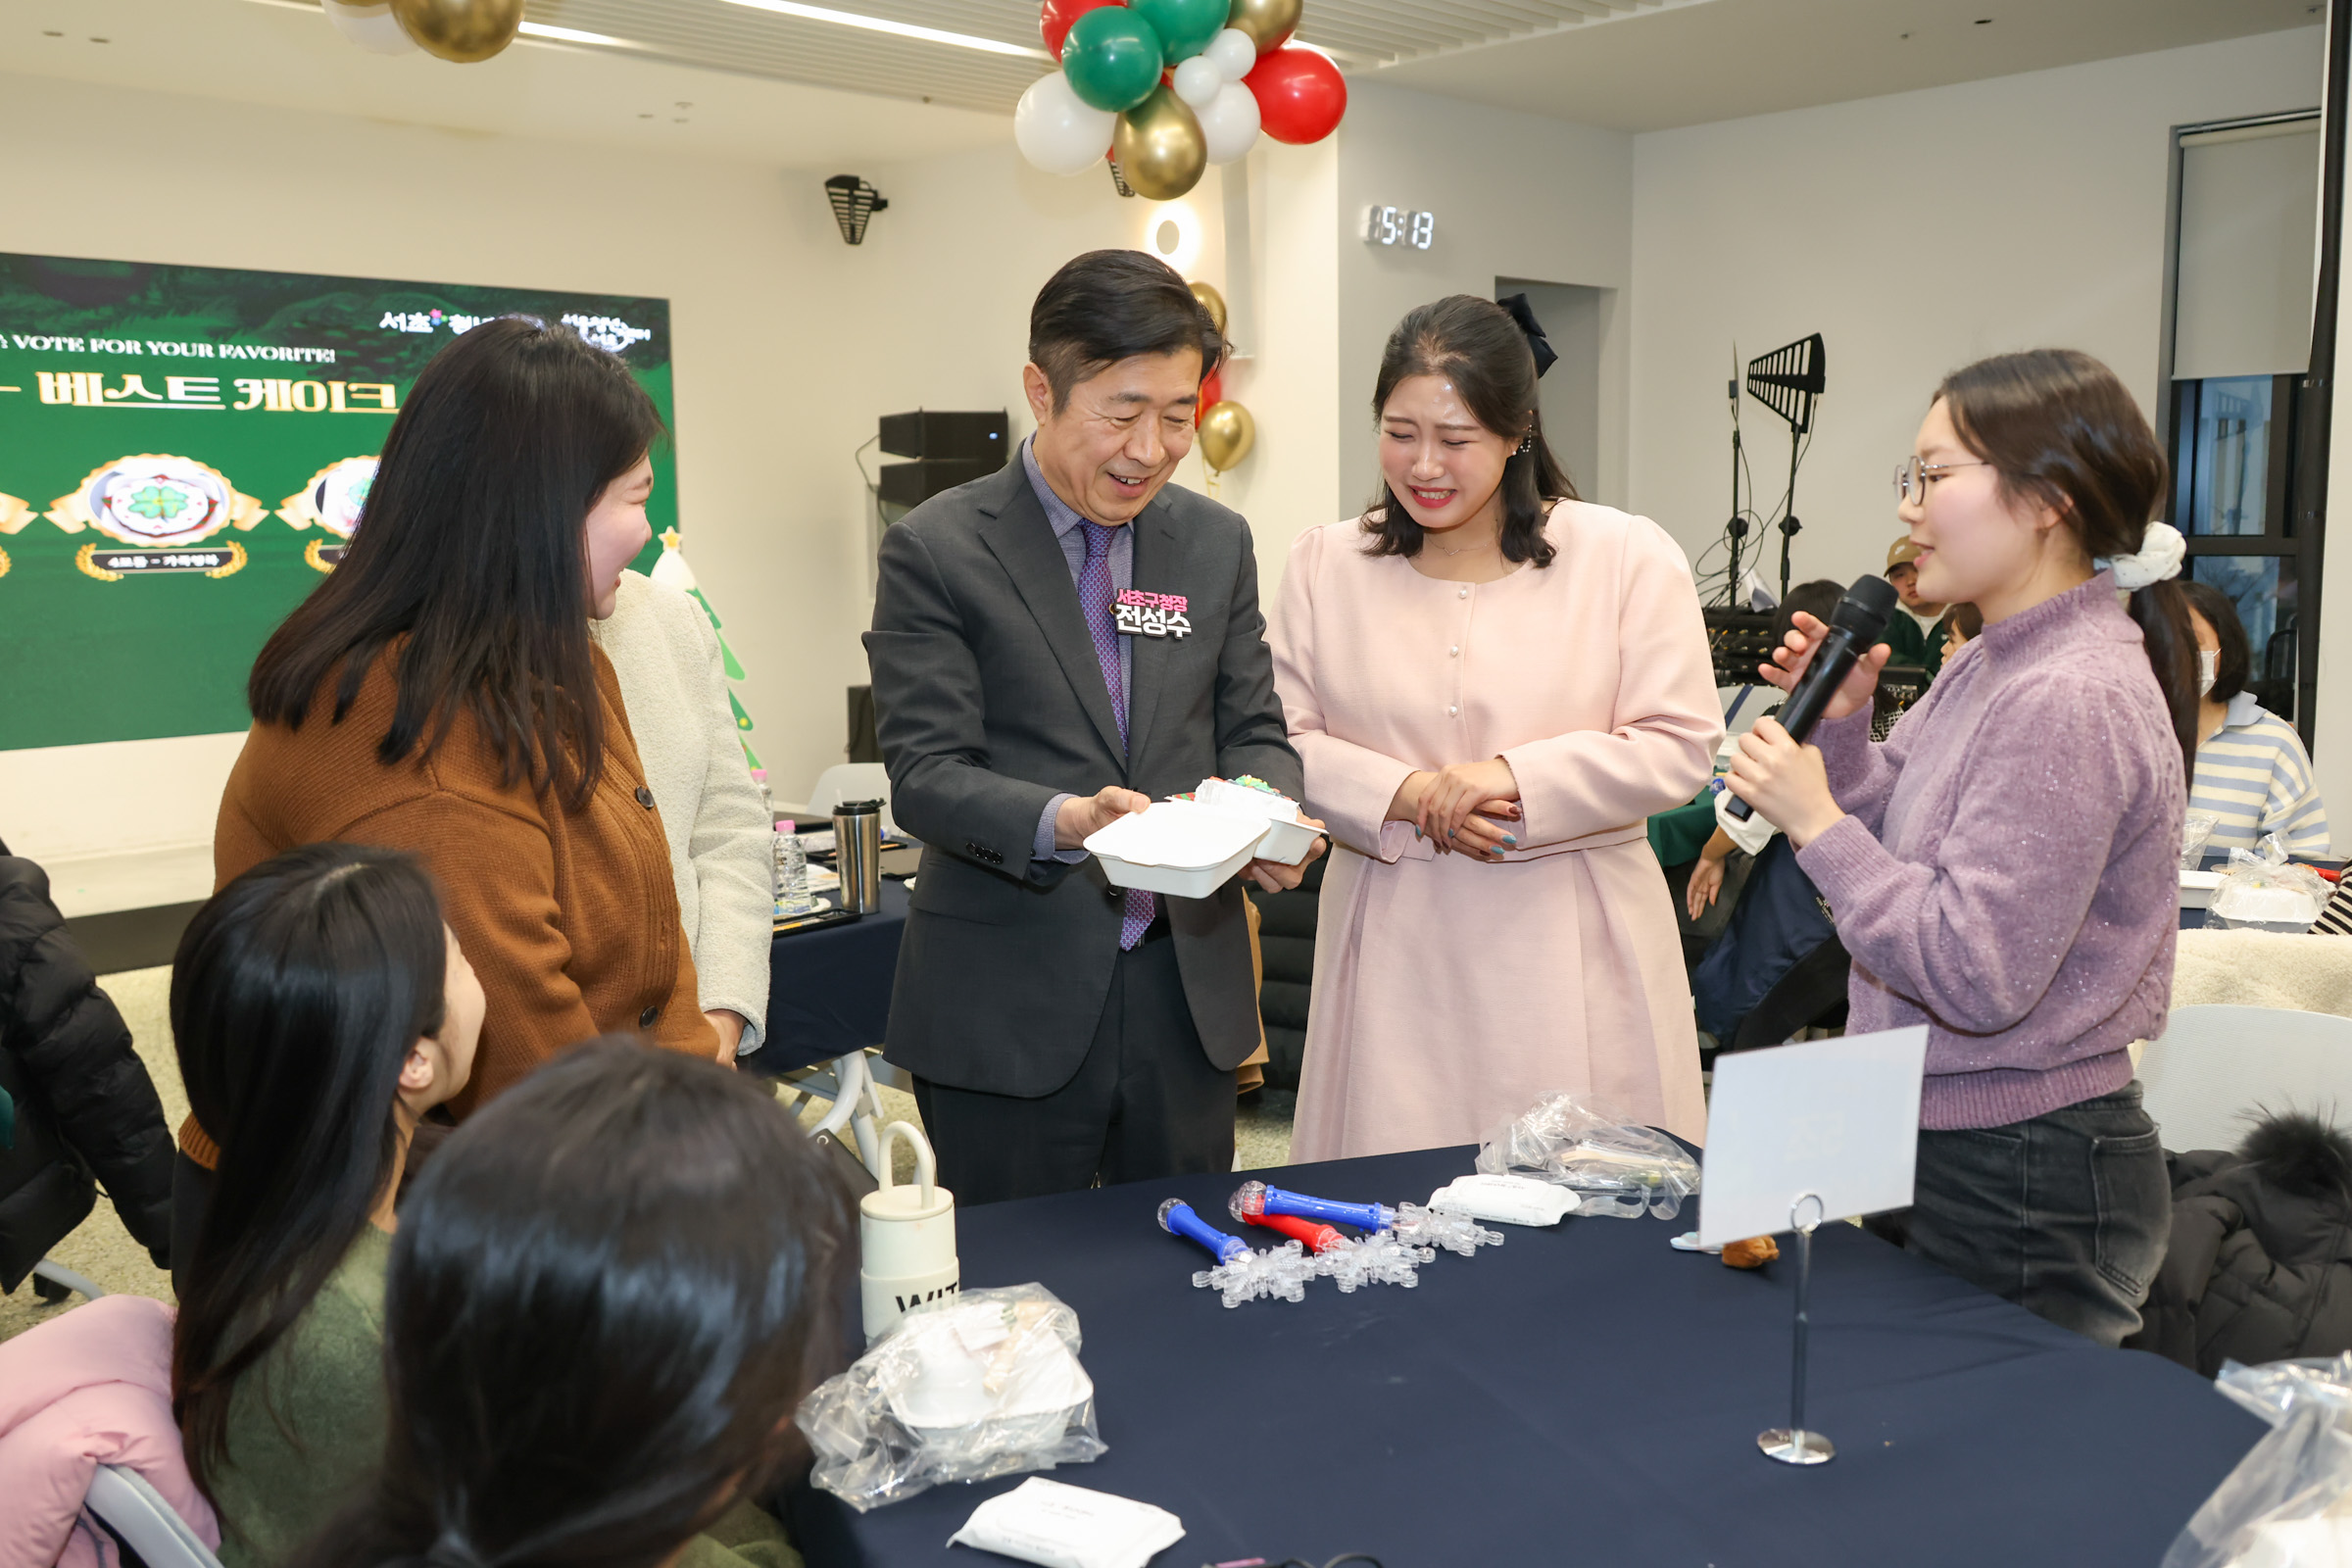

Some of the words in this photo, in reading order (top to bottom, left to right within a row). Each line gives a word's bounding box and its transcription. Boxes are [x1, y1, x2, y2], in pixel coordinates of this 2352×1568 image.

[378, 312, 434, 333] 서초
[12, 334, 85, 353] VOTE
[89, 337, 144, 356] FOR
[146, 339, 216, 359] YOUR
[219, 344, 336, 364] FAVORITE!
[34, 370, 226, 411] 베스트
[232, 378, 400, 414] 케이크
[1116, 588, 1189, 613] 서초구청장
[1115, 604, 1193, 640] 전성수
